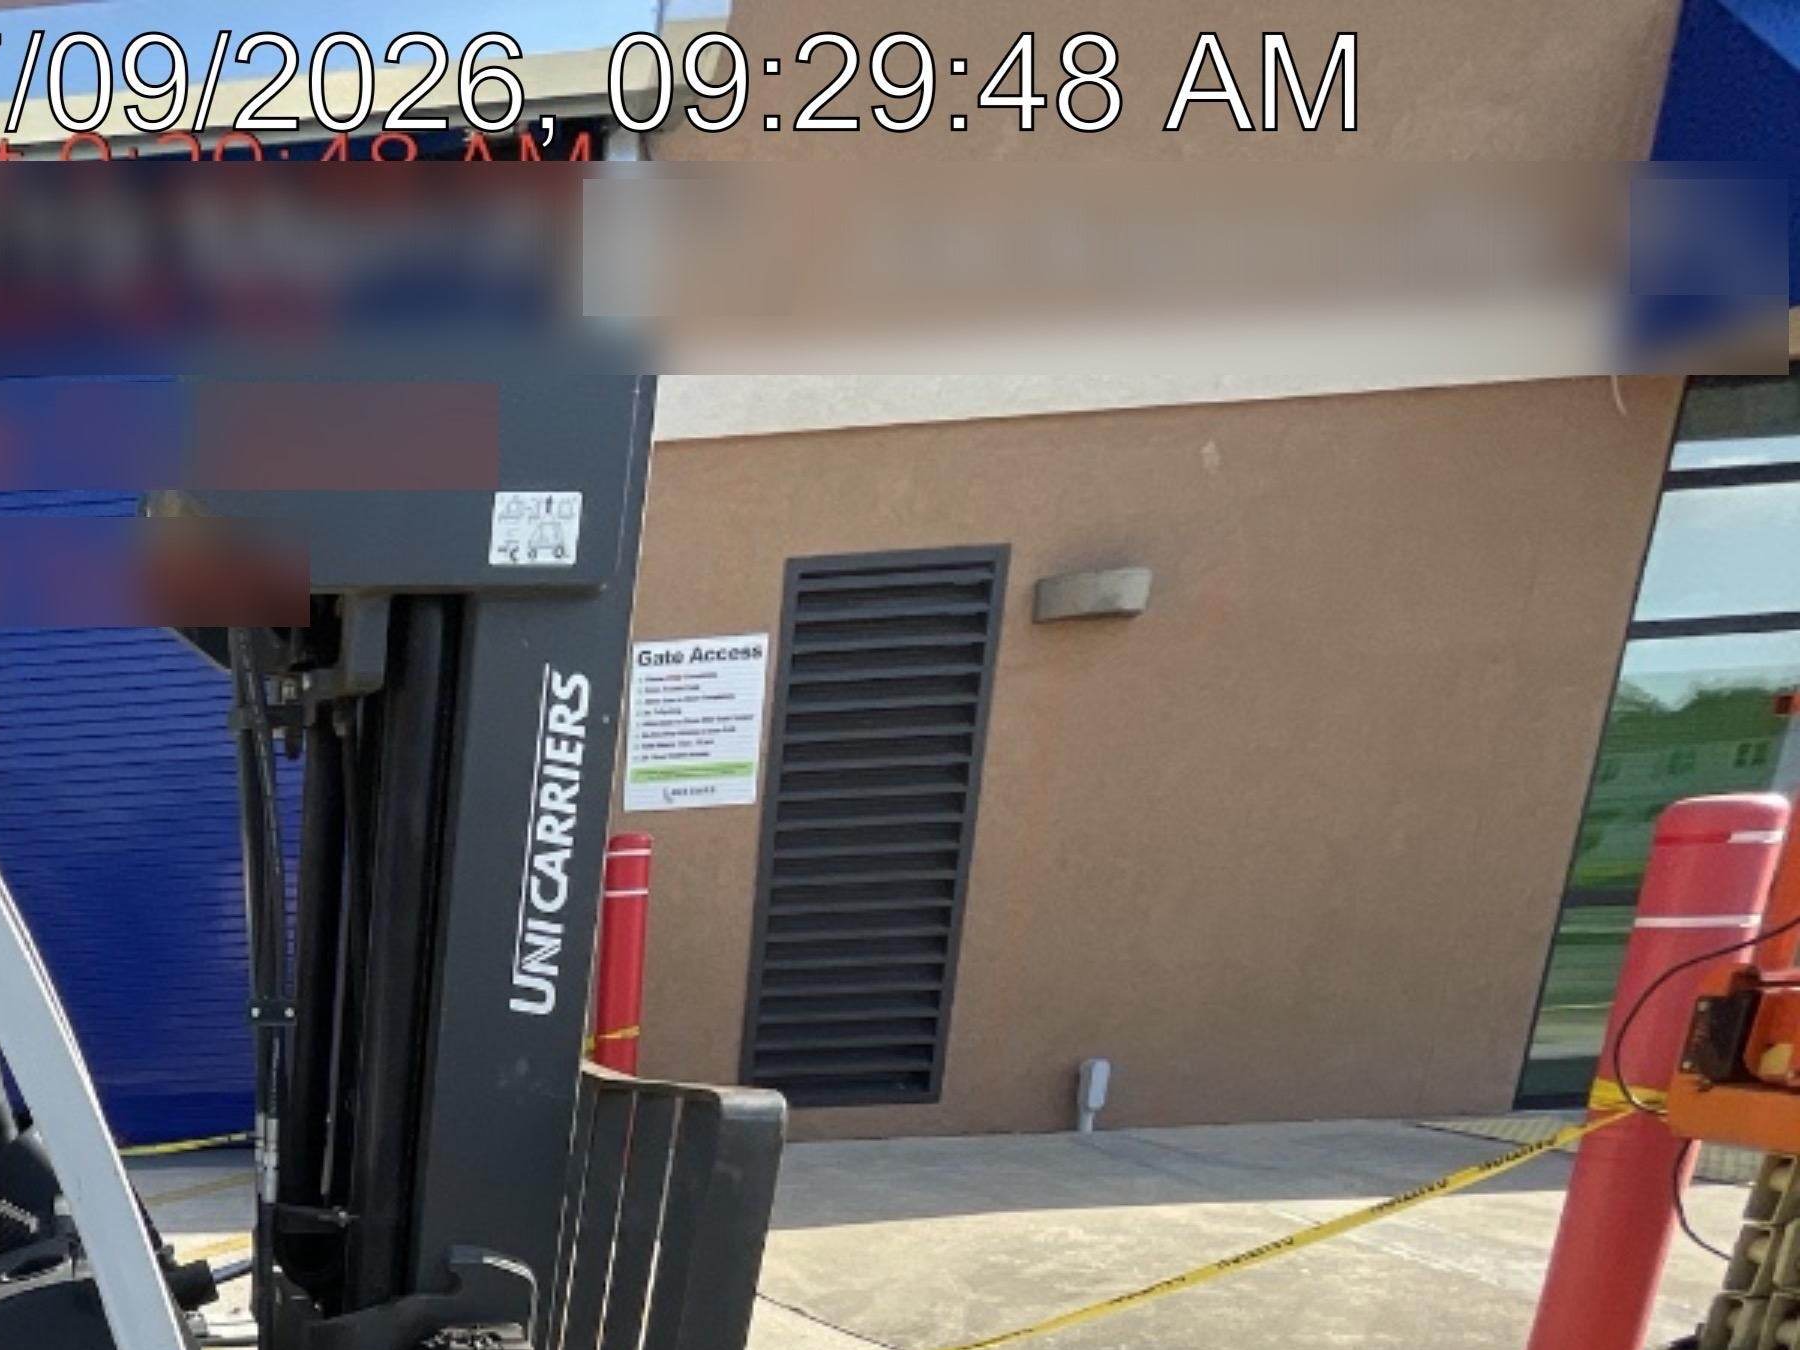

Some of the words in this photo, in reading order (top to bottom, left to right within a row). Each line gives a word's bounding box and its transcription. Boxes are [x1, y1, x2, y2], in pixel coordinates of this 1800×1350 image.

[637, 650, 684, 667] Gate
[689, 646, 763, 664] Access
[509, 664, 591, 1015] UNICARRIERS
